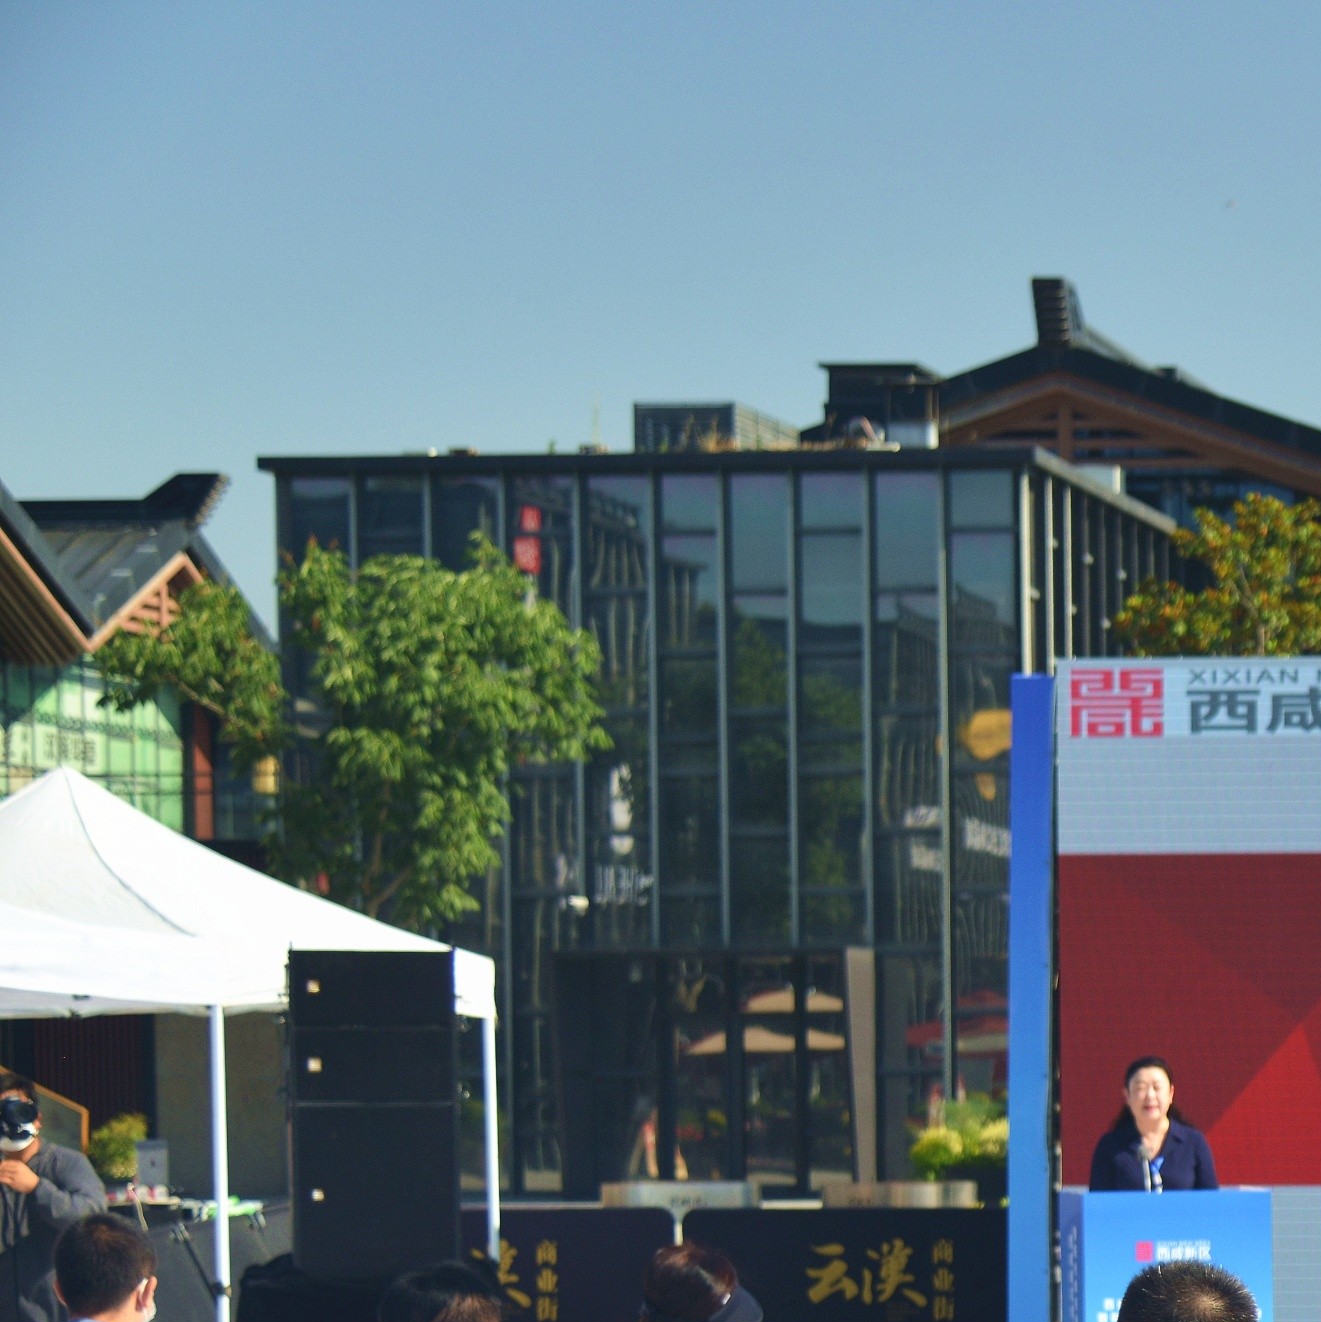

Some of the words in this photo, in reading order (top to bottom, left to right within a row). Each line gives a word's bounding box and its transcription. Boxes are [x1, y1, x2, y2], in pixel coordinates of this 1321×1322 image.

[1188, 667, 1300, 685] XIXIAN
[536, 1239, 559, 1322] 商业街
[931, 1238, 956, 1322] 商业街
